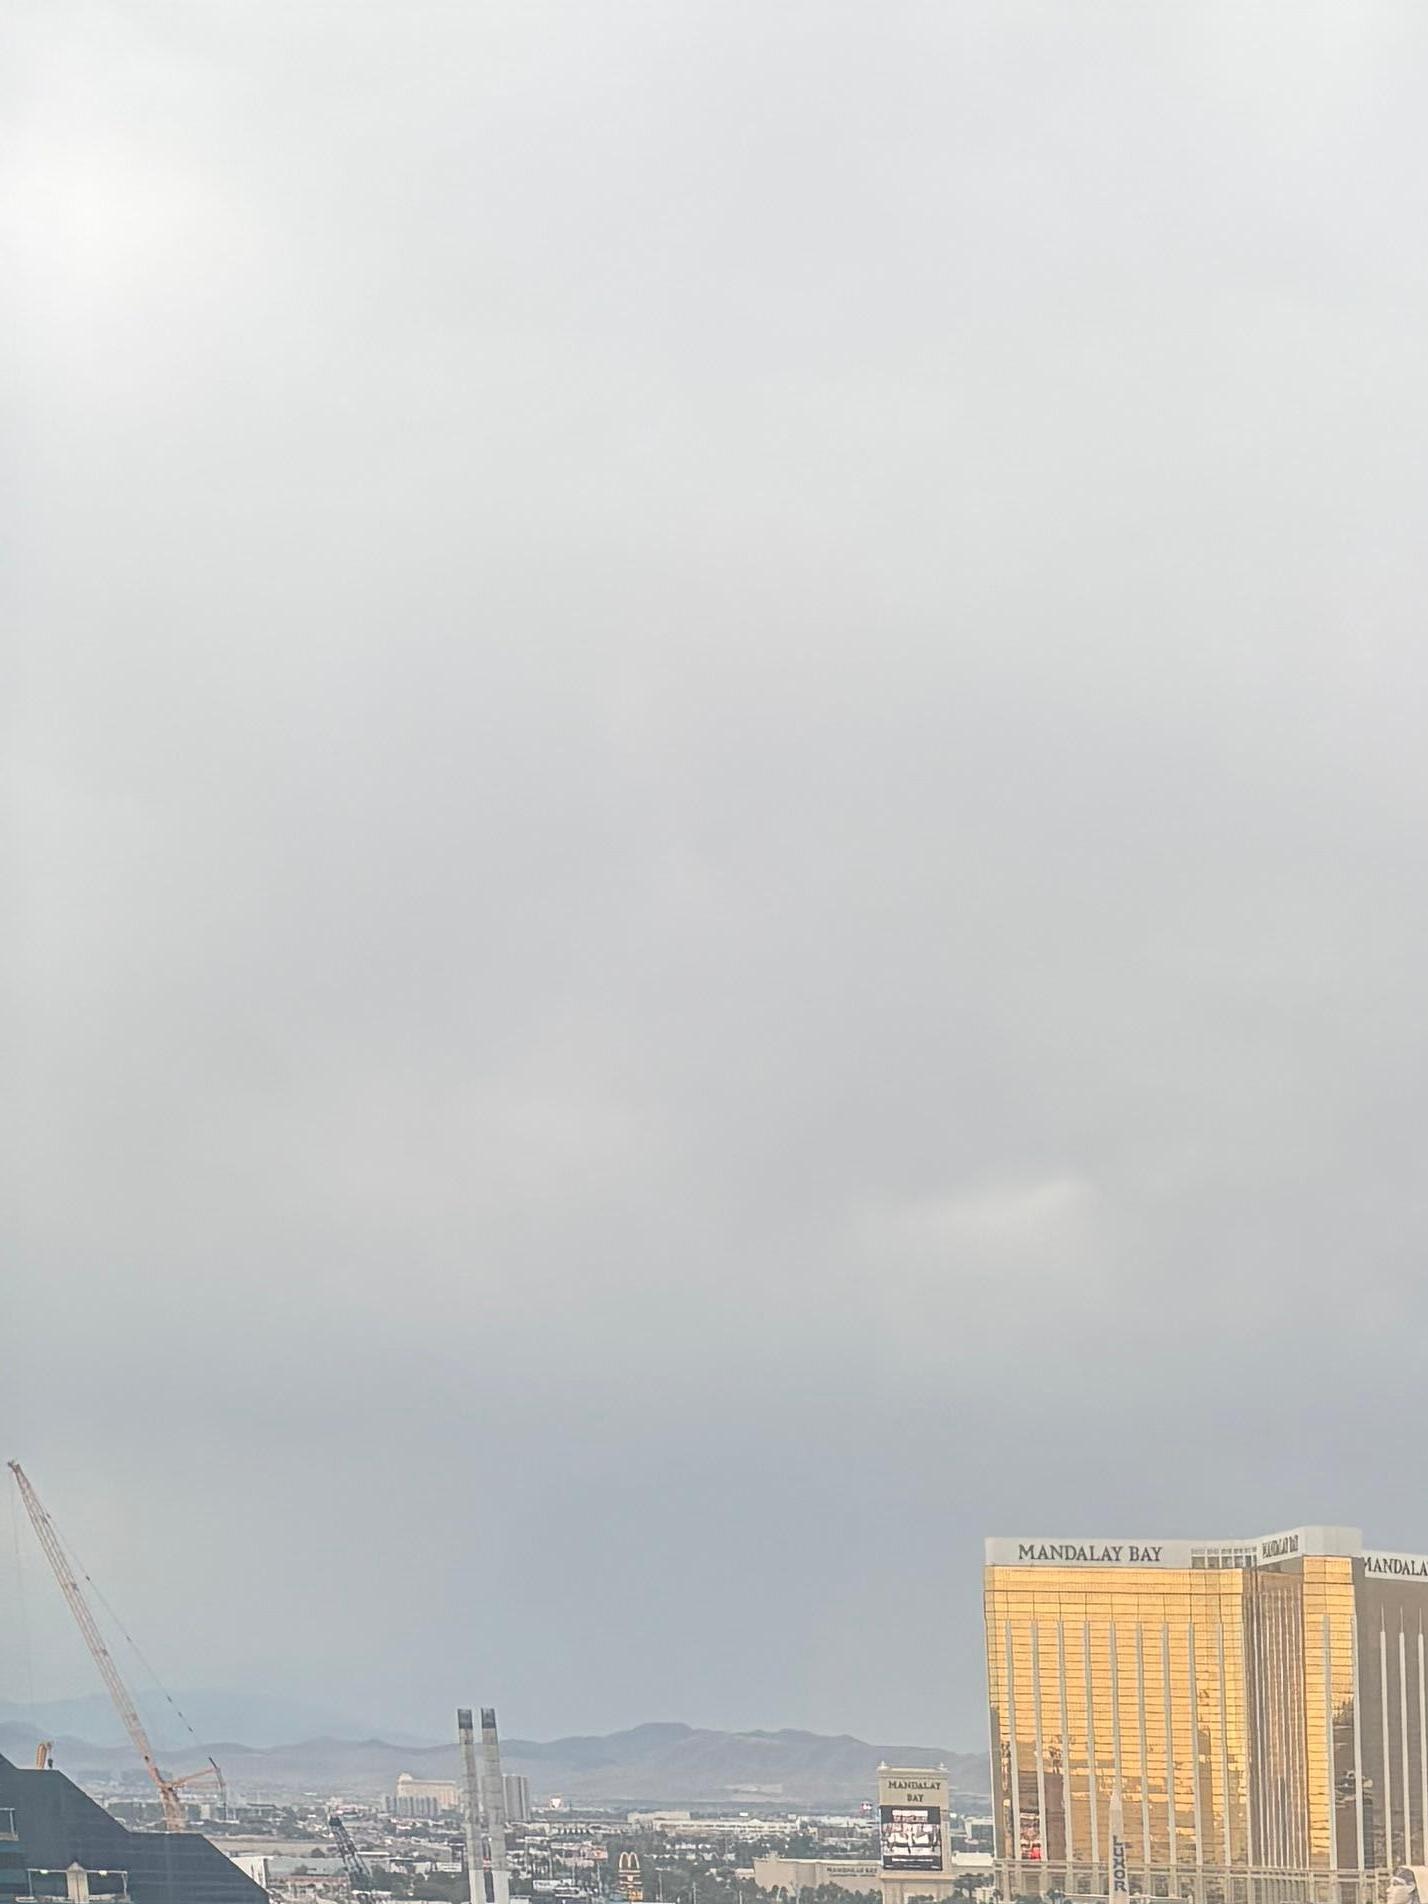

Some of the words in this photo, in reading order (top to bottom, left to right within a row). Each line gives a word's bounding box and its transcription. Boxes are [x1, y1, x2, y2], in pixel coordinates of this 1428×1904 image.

[1018, 1544, 1122, 1562] MANDALAY
[1129, 1546, 1163, 1562] BAY
[888, 1780, 941, 1791] MANDALAY
[907, 1794, 924, 1803] BAY
[1112, 1834, 1128, 1892] LUXOR
